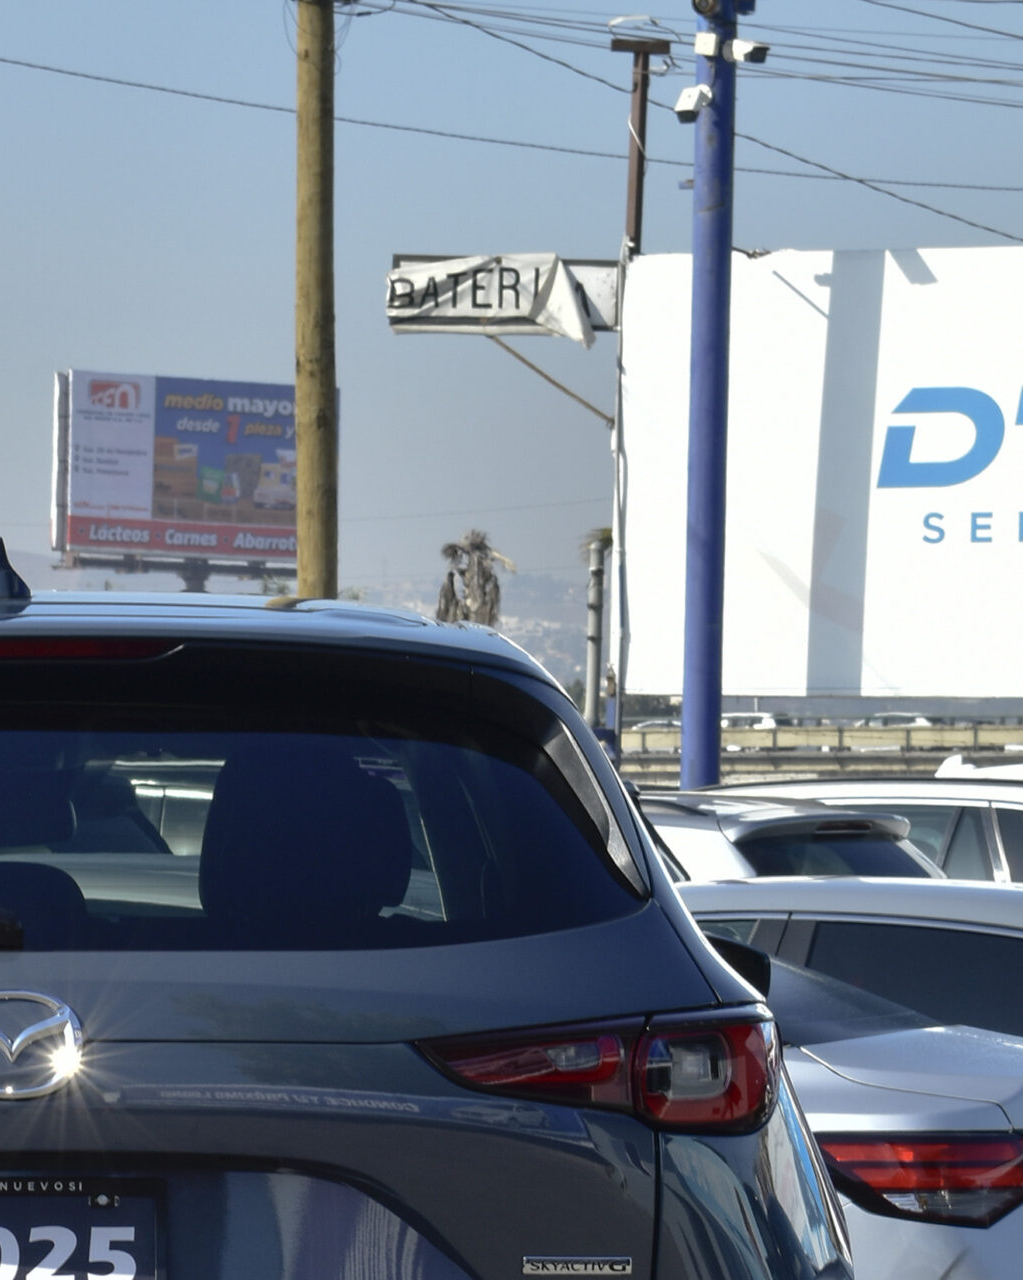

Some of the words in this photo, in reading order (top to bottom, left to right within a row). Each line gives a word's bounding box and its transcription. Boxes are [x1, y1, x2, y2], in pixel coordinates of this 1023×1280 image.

[389, 266, 591, 318] BATERI
[164, 394, 224, 411] medio
[227, 397, 296, 418] mayo
[176, 418, 220, 433] desde
[225, 414, 241, 444] 1
[244, 421, 282, 436] pieza
[89, 524, 150, 542] Lácteos
[164, 529, 218, 546] Carnes
[233, 532, 297, 551] Abarrot
[922, 511, 1023, 544] SE
